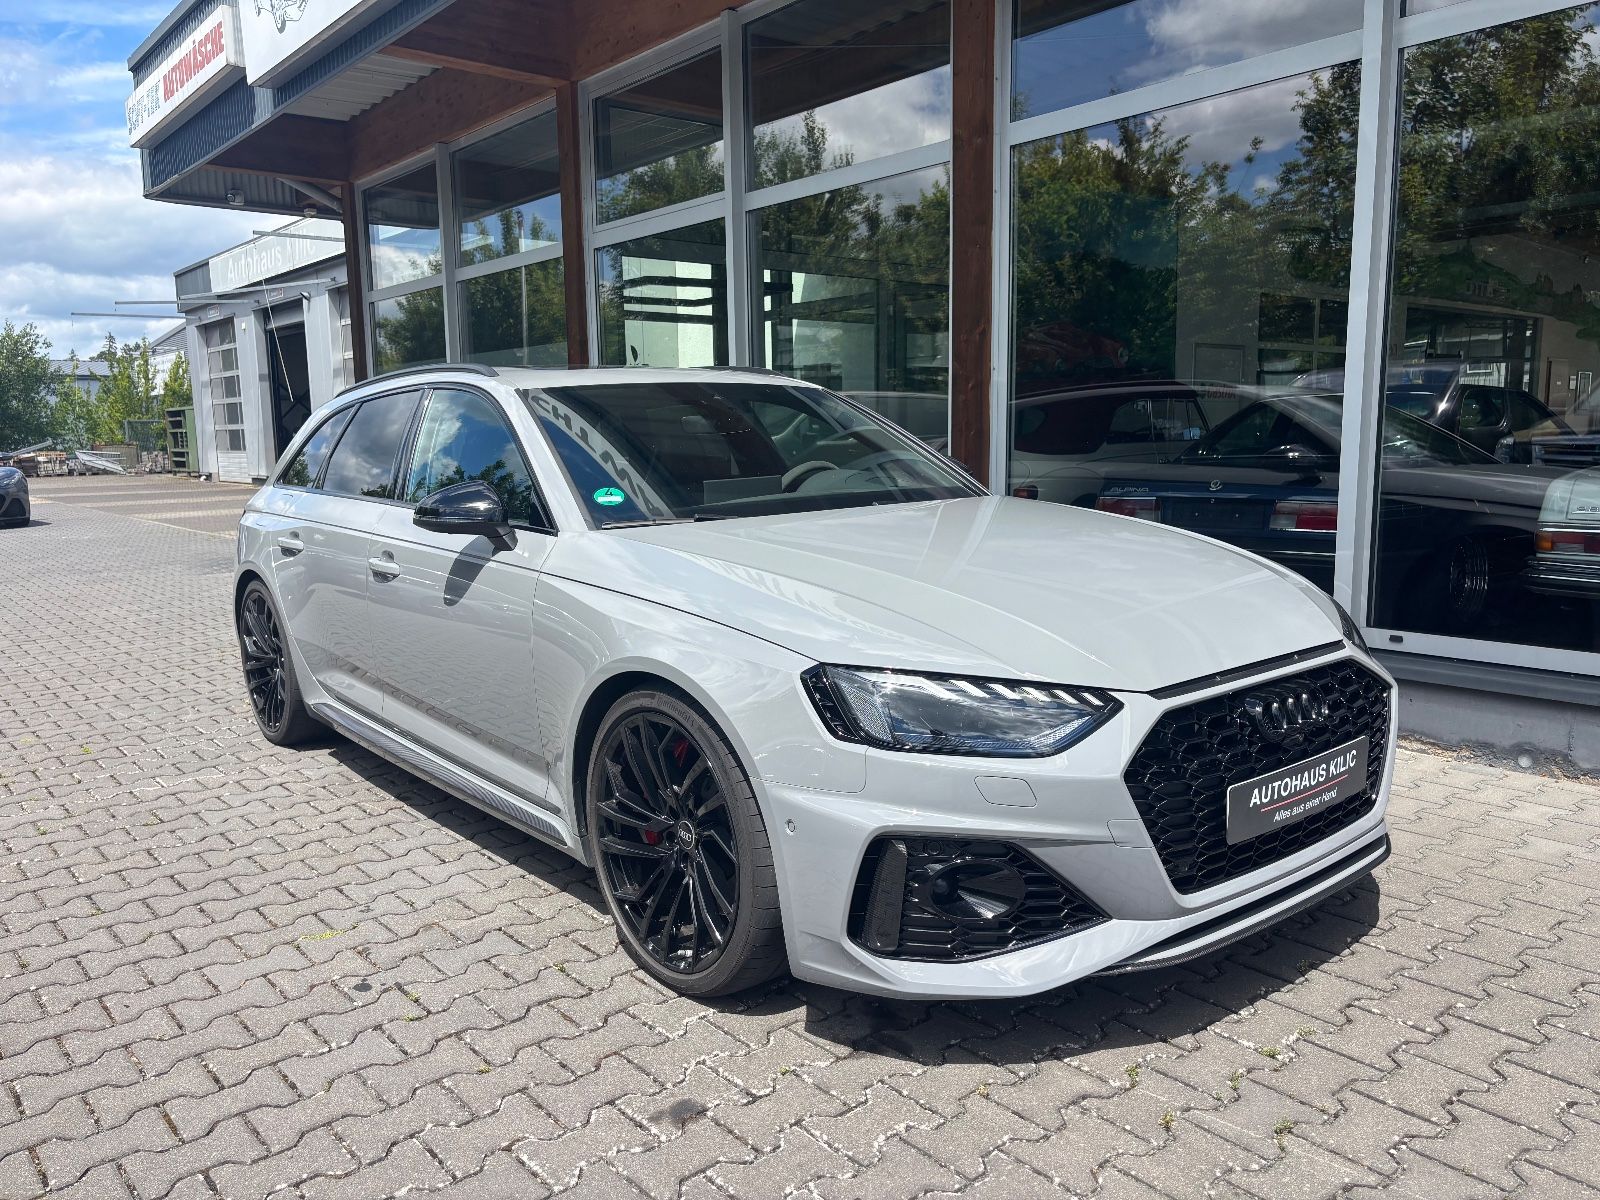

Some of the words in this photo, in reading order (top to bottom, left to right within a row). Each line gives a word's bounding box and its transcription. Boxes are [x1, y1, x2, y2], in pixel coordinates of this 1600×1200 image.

[162, 20, 224, 103] AUTOWÄSCHE
[227, 245, 282, 283] Autohaus
[604, 488, 614, 496] 4
[1249, 763, 1327, 808] AUTOHAUS
[1329, 749, 1357, 778] KILIC
[1273, 808, 1291, 823] Alles
[1291, 803, 1305, 816] aus
[1305, 796, 1322, 810] einer
[1321, 787, 1338, 803] Hand
